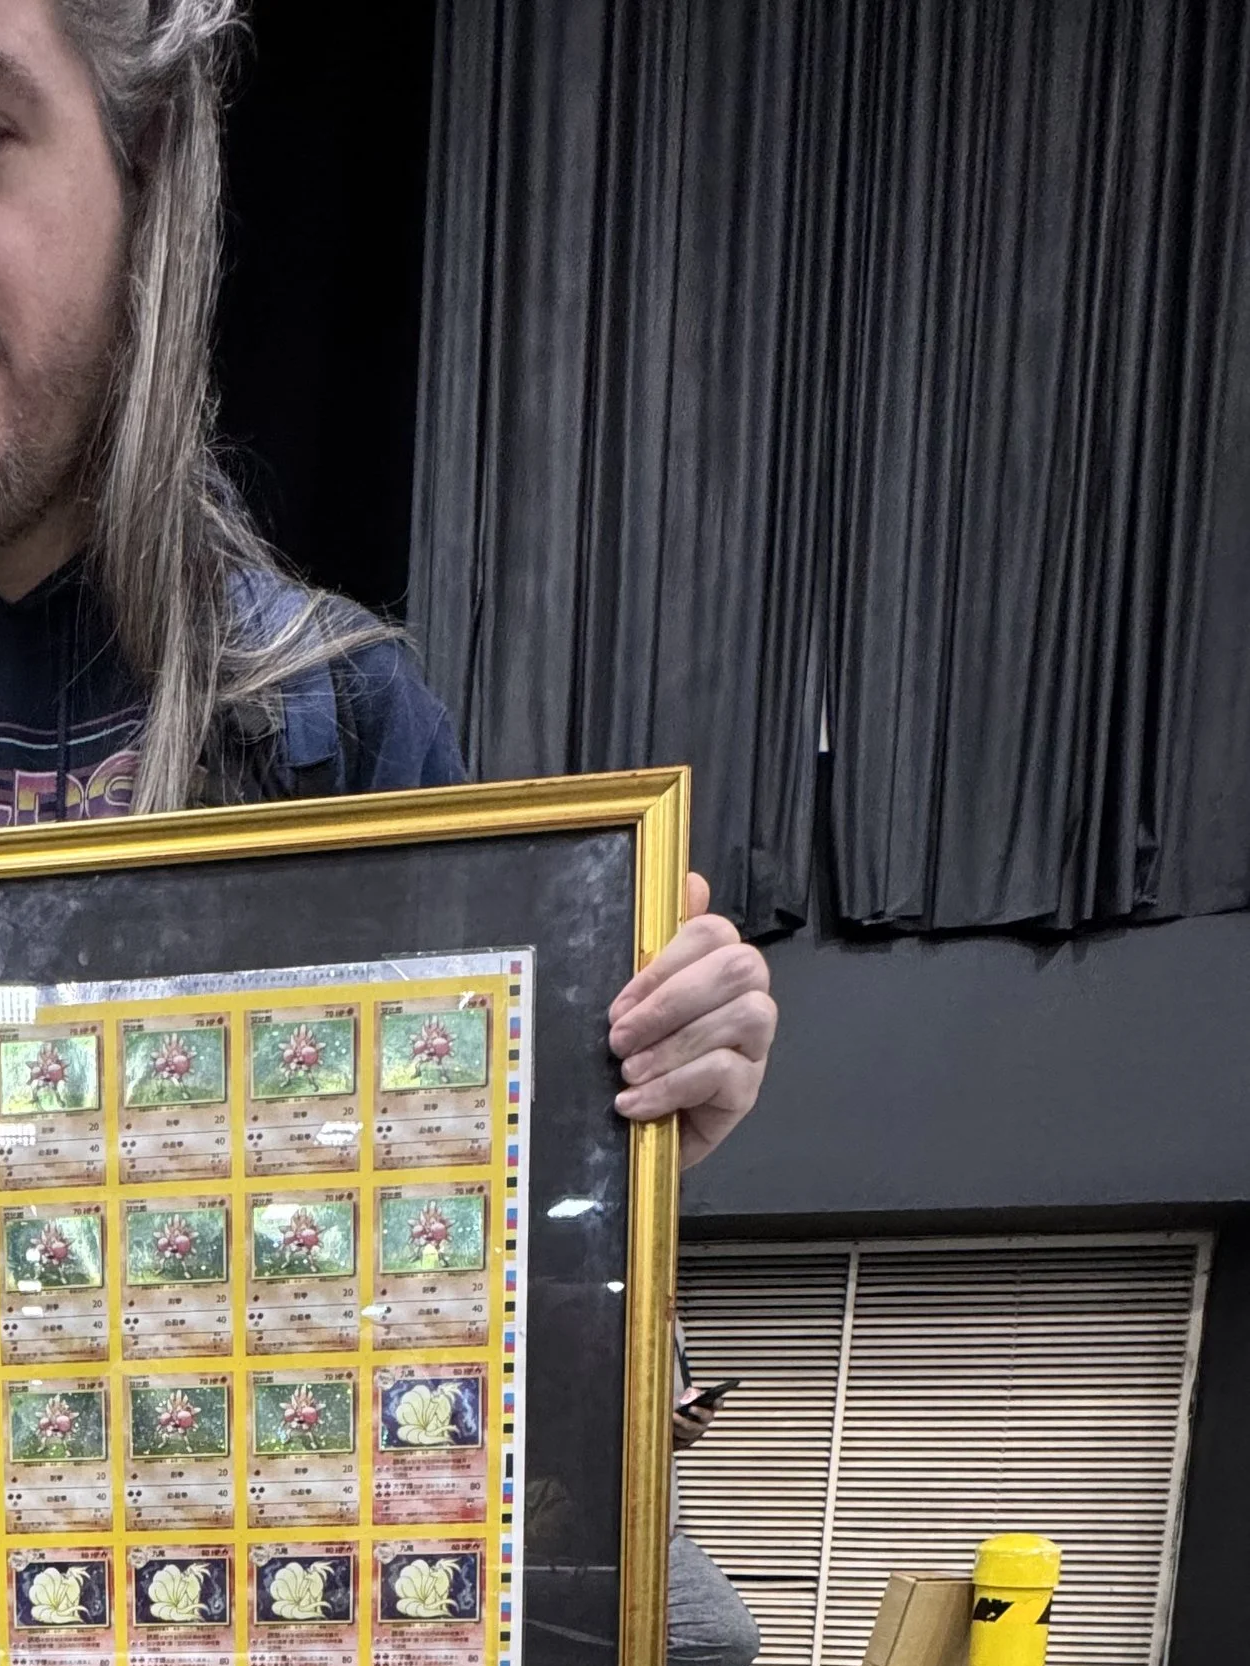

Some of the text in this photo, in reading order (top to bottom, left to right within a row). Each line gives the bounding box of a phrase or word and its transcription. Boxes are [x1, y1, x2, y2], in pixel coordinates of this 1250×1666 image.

[474, 1099, 485, 1108] 20
[343, 1106, 353, 1115] 20
[214, 1115, 225, 1123] 20
[88, 1122, 99, 1131] 20
[474, 1122, 485, 1130] 40
[214, 1137, 225, 1145] 40
[89, 1144, 99, 1152] 40
[472, 1282, 483, 1291] 20
[343, 1288, 353, 1296] 20
[216, 1294, 226, 1302] 20
[92, 1299, 102, 1308] 20
[472, 1304, 482, 1312] 40
[342, 1310, 353, 1318] 40
[218, 1468, 228, 1476] 20
[342, 1464, 353, 1472] 20
[96, 1472, 106, 1480] 20
[217, 1489, 228, 1497] 40
